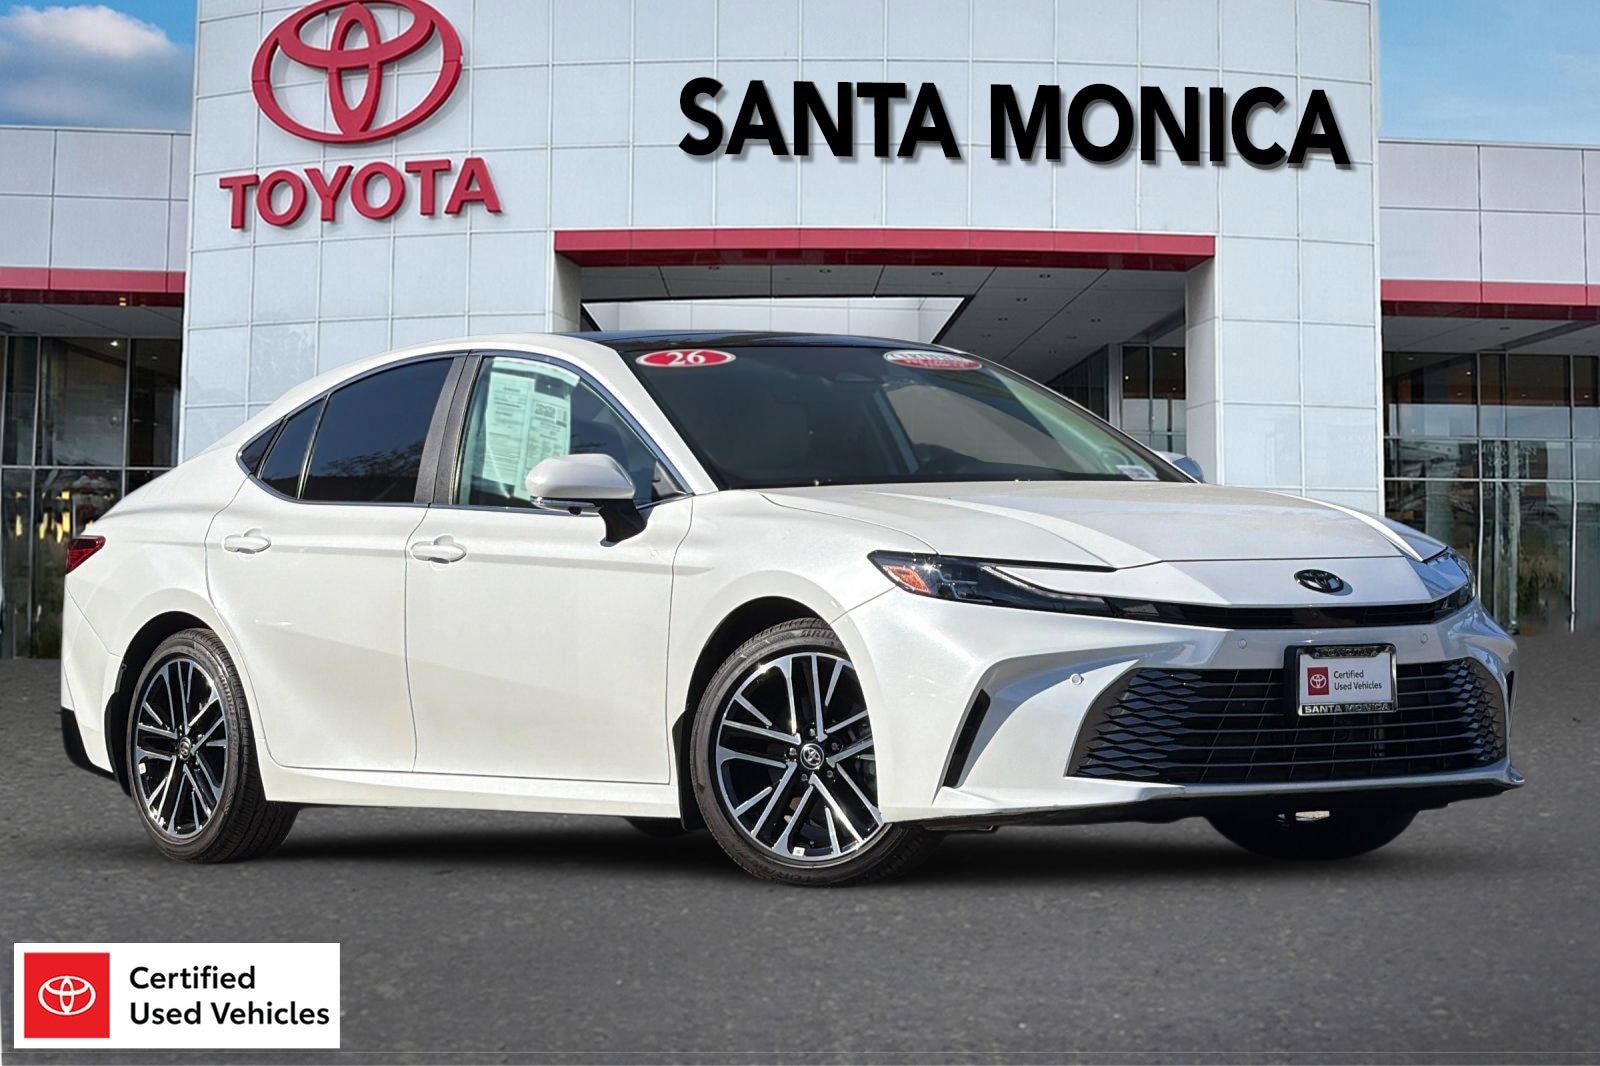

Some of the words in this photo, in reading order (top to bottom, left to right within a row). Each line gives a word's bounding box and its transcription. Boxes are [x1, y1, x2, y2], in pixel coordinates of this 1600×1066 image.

[679, 78, 960, 159] SANTA
[990, 84, 1351, 169] MONICA
[220, 156, 502, 229] TOYOTA
[666, 350, 705, 366] 26
[1333, 670, 1364, 679] Certified
[1334, 682, 1352, 690] Used
[1353, 680, 1383, 690] Vehicles
[1304, 705, 1342, 714] SANTA
[1344, 703, 1390, 712] MONICA
